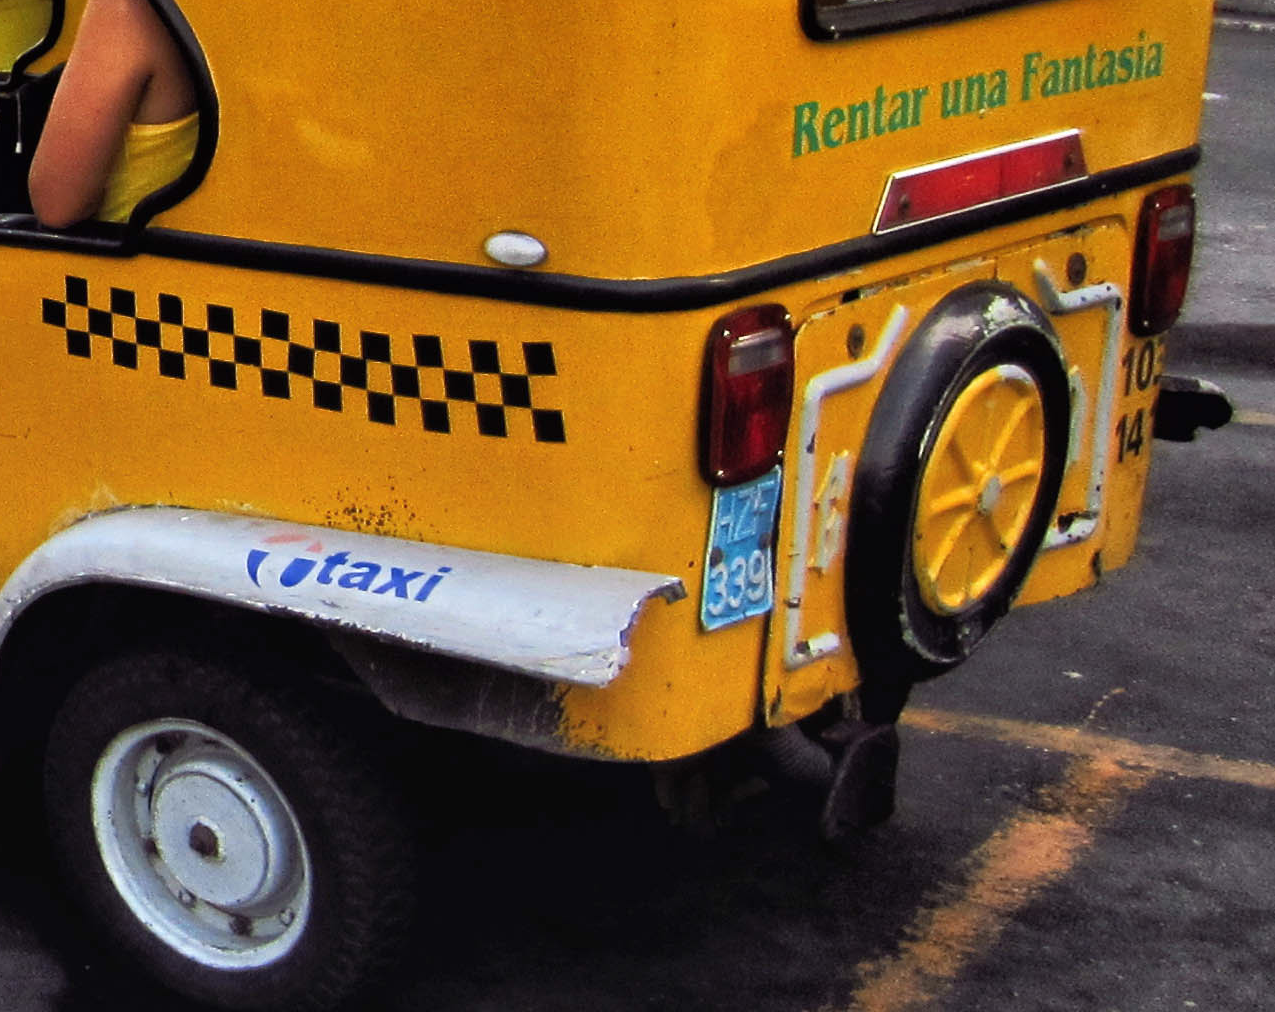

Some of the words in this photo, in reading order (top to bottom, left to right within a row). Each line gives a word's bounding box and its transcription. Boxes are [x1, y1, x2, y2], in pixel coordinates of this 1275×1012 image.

[792, 83, 929, 158] Rentar
[940, 68, 1007, 119] una
[1020, 29, 1164, 102] Fantasia
[1121, 339, 1163, 397] 10
[1115, 409, 1143, 463] 14
[707, 549, 766, 616] 339
